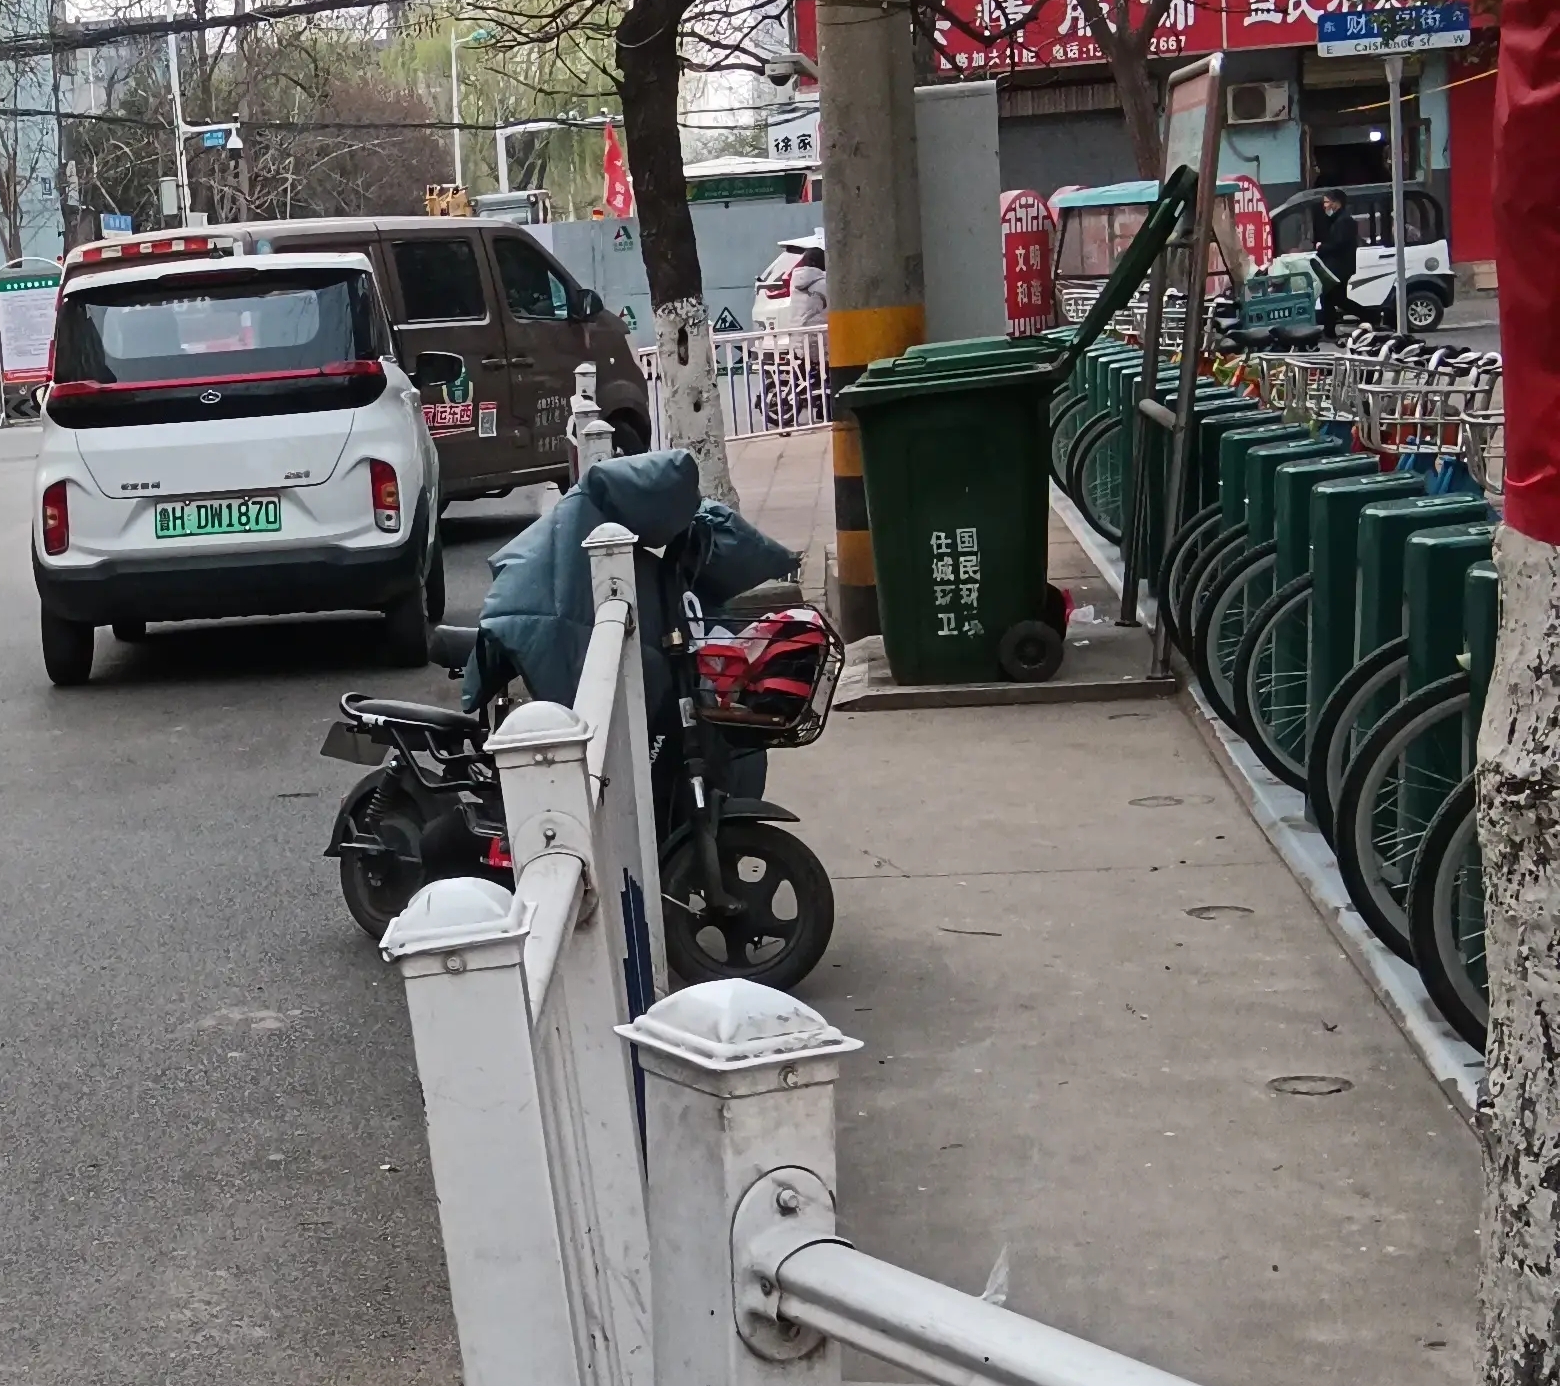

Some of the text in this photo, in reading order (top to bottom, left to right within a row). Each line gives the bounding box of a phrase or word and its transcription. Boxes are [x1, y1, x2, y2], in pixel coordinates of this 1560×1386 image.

[773, 133, 813, 154] 徐家
[1015, 244, 1042, 273] 文明
[1016, 277, 1043, 307] 和谐
